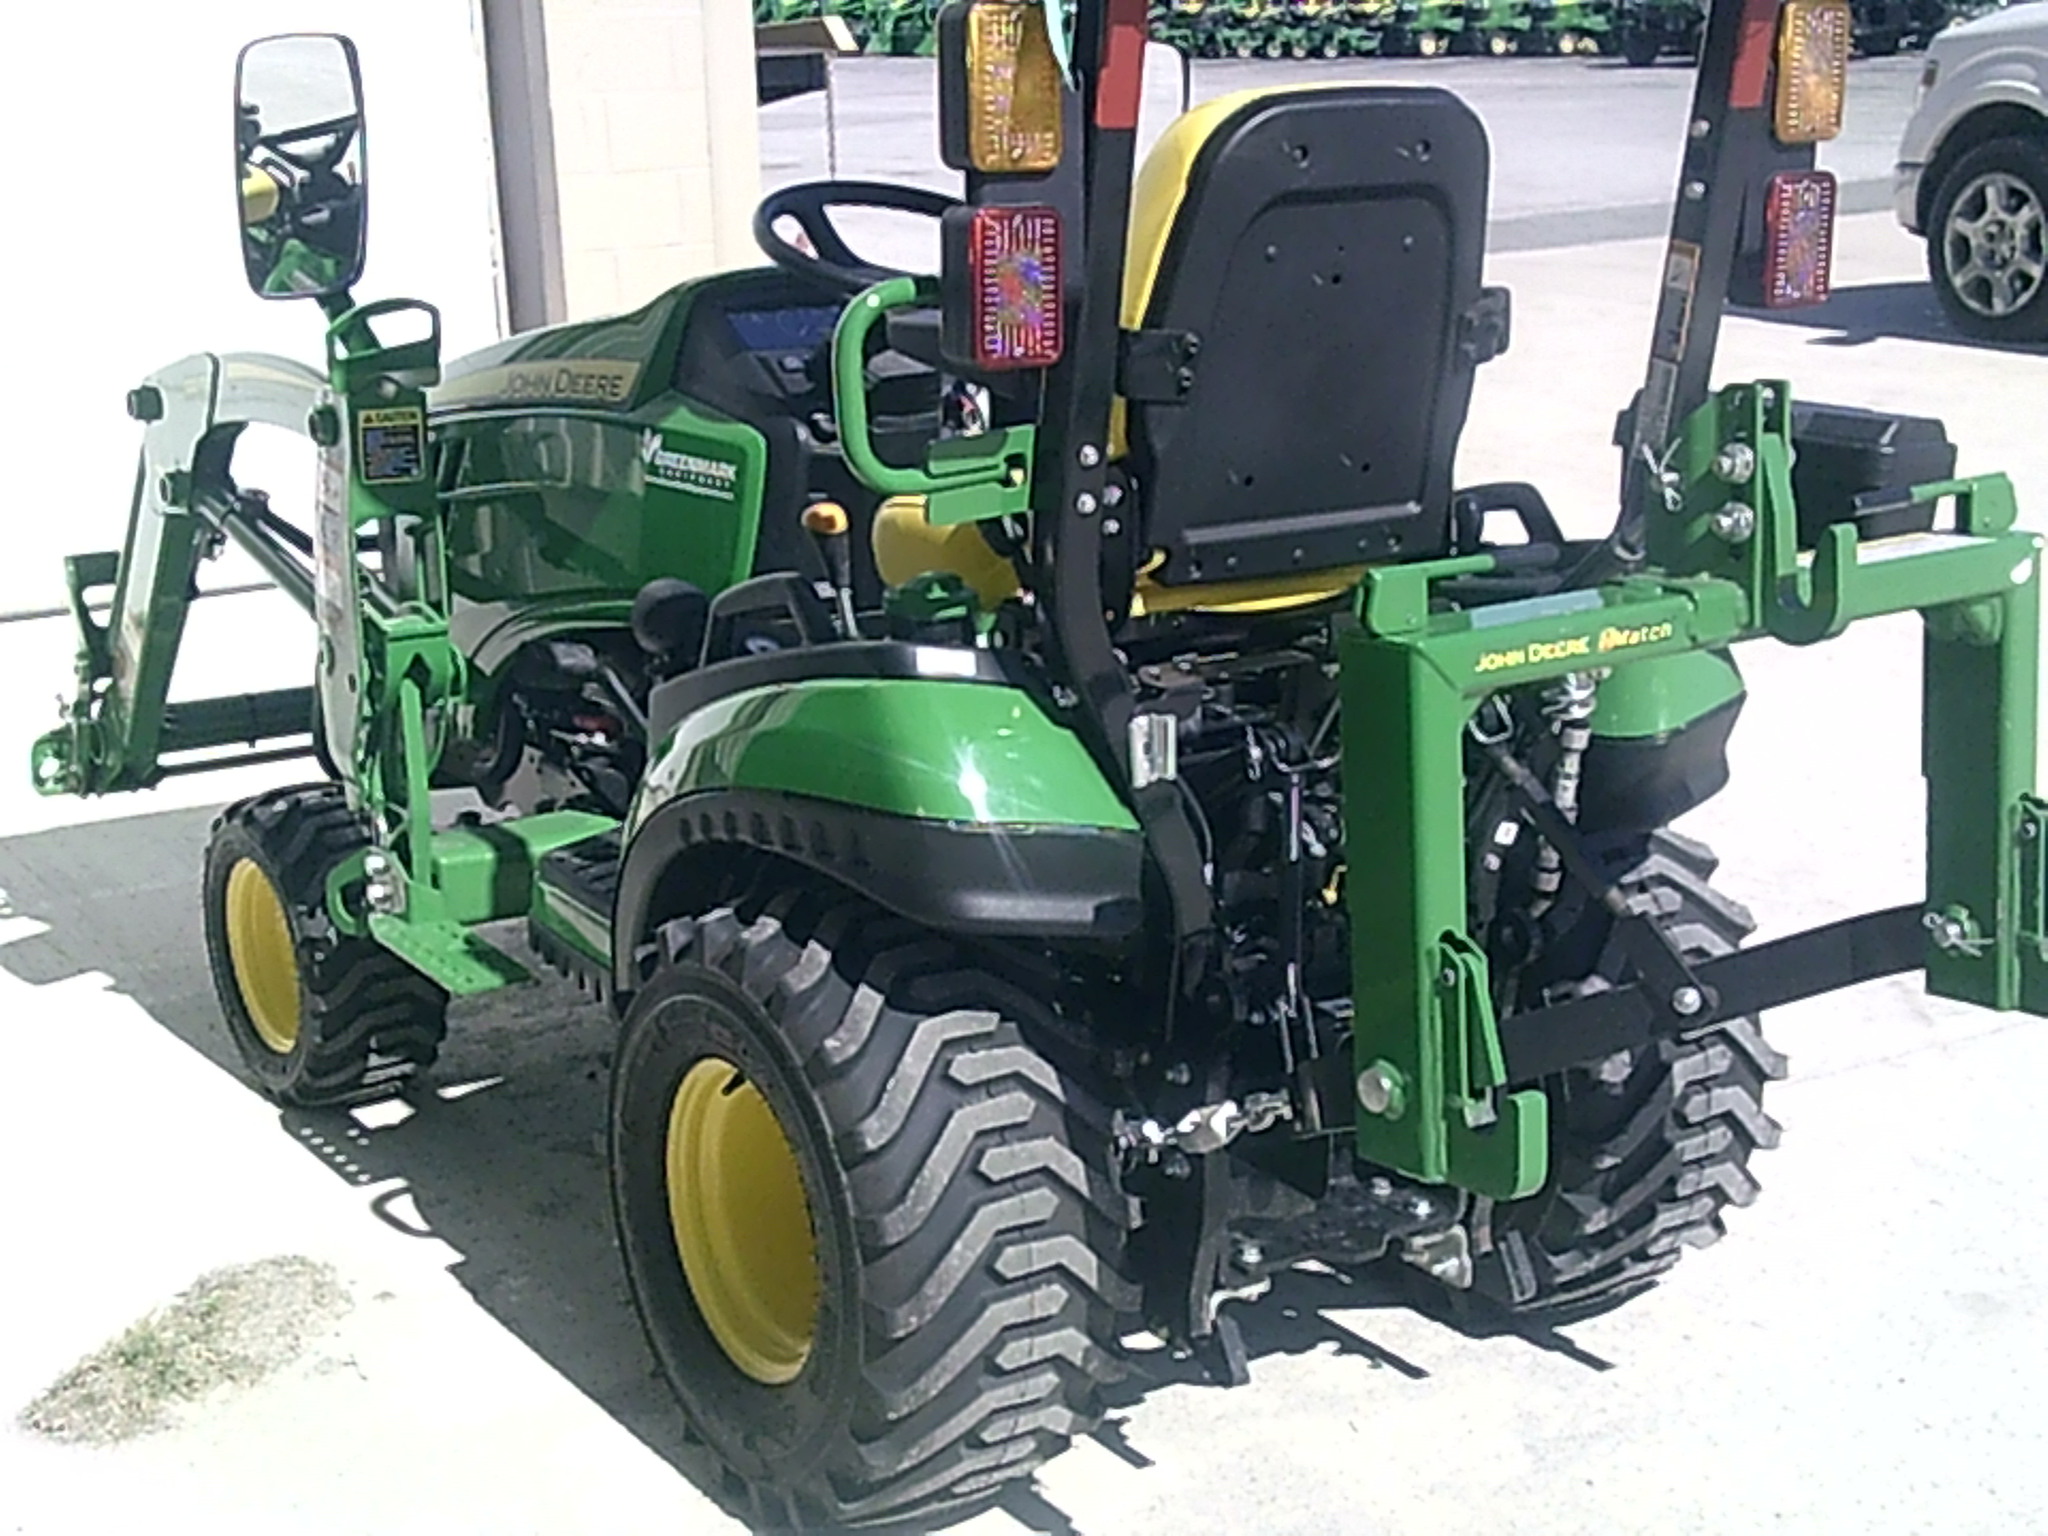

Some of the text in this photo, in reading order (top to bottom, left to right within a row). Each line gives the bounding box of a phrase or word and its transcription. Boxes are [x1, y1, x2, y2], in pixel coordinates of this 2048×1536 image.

[554, 367, 624, 397] DEERE
[1474, 649, 1525, 672] JOHN
[1528, 635, 1590, 663] DEERE
